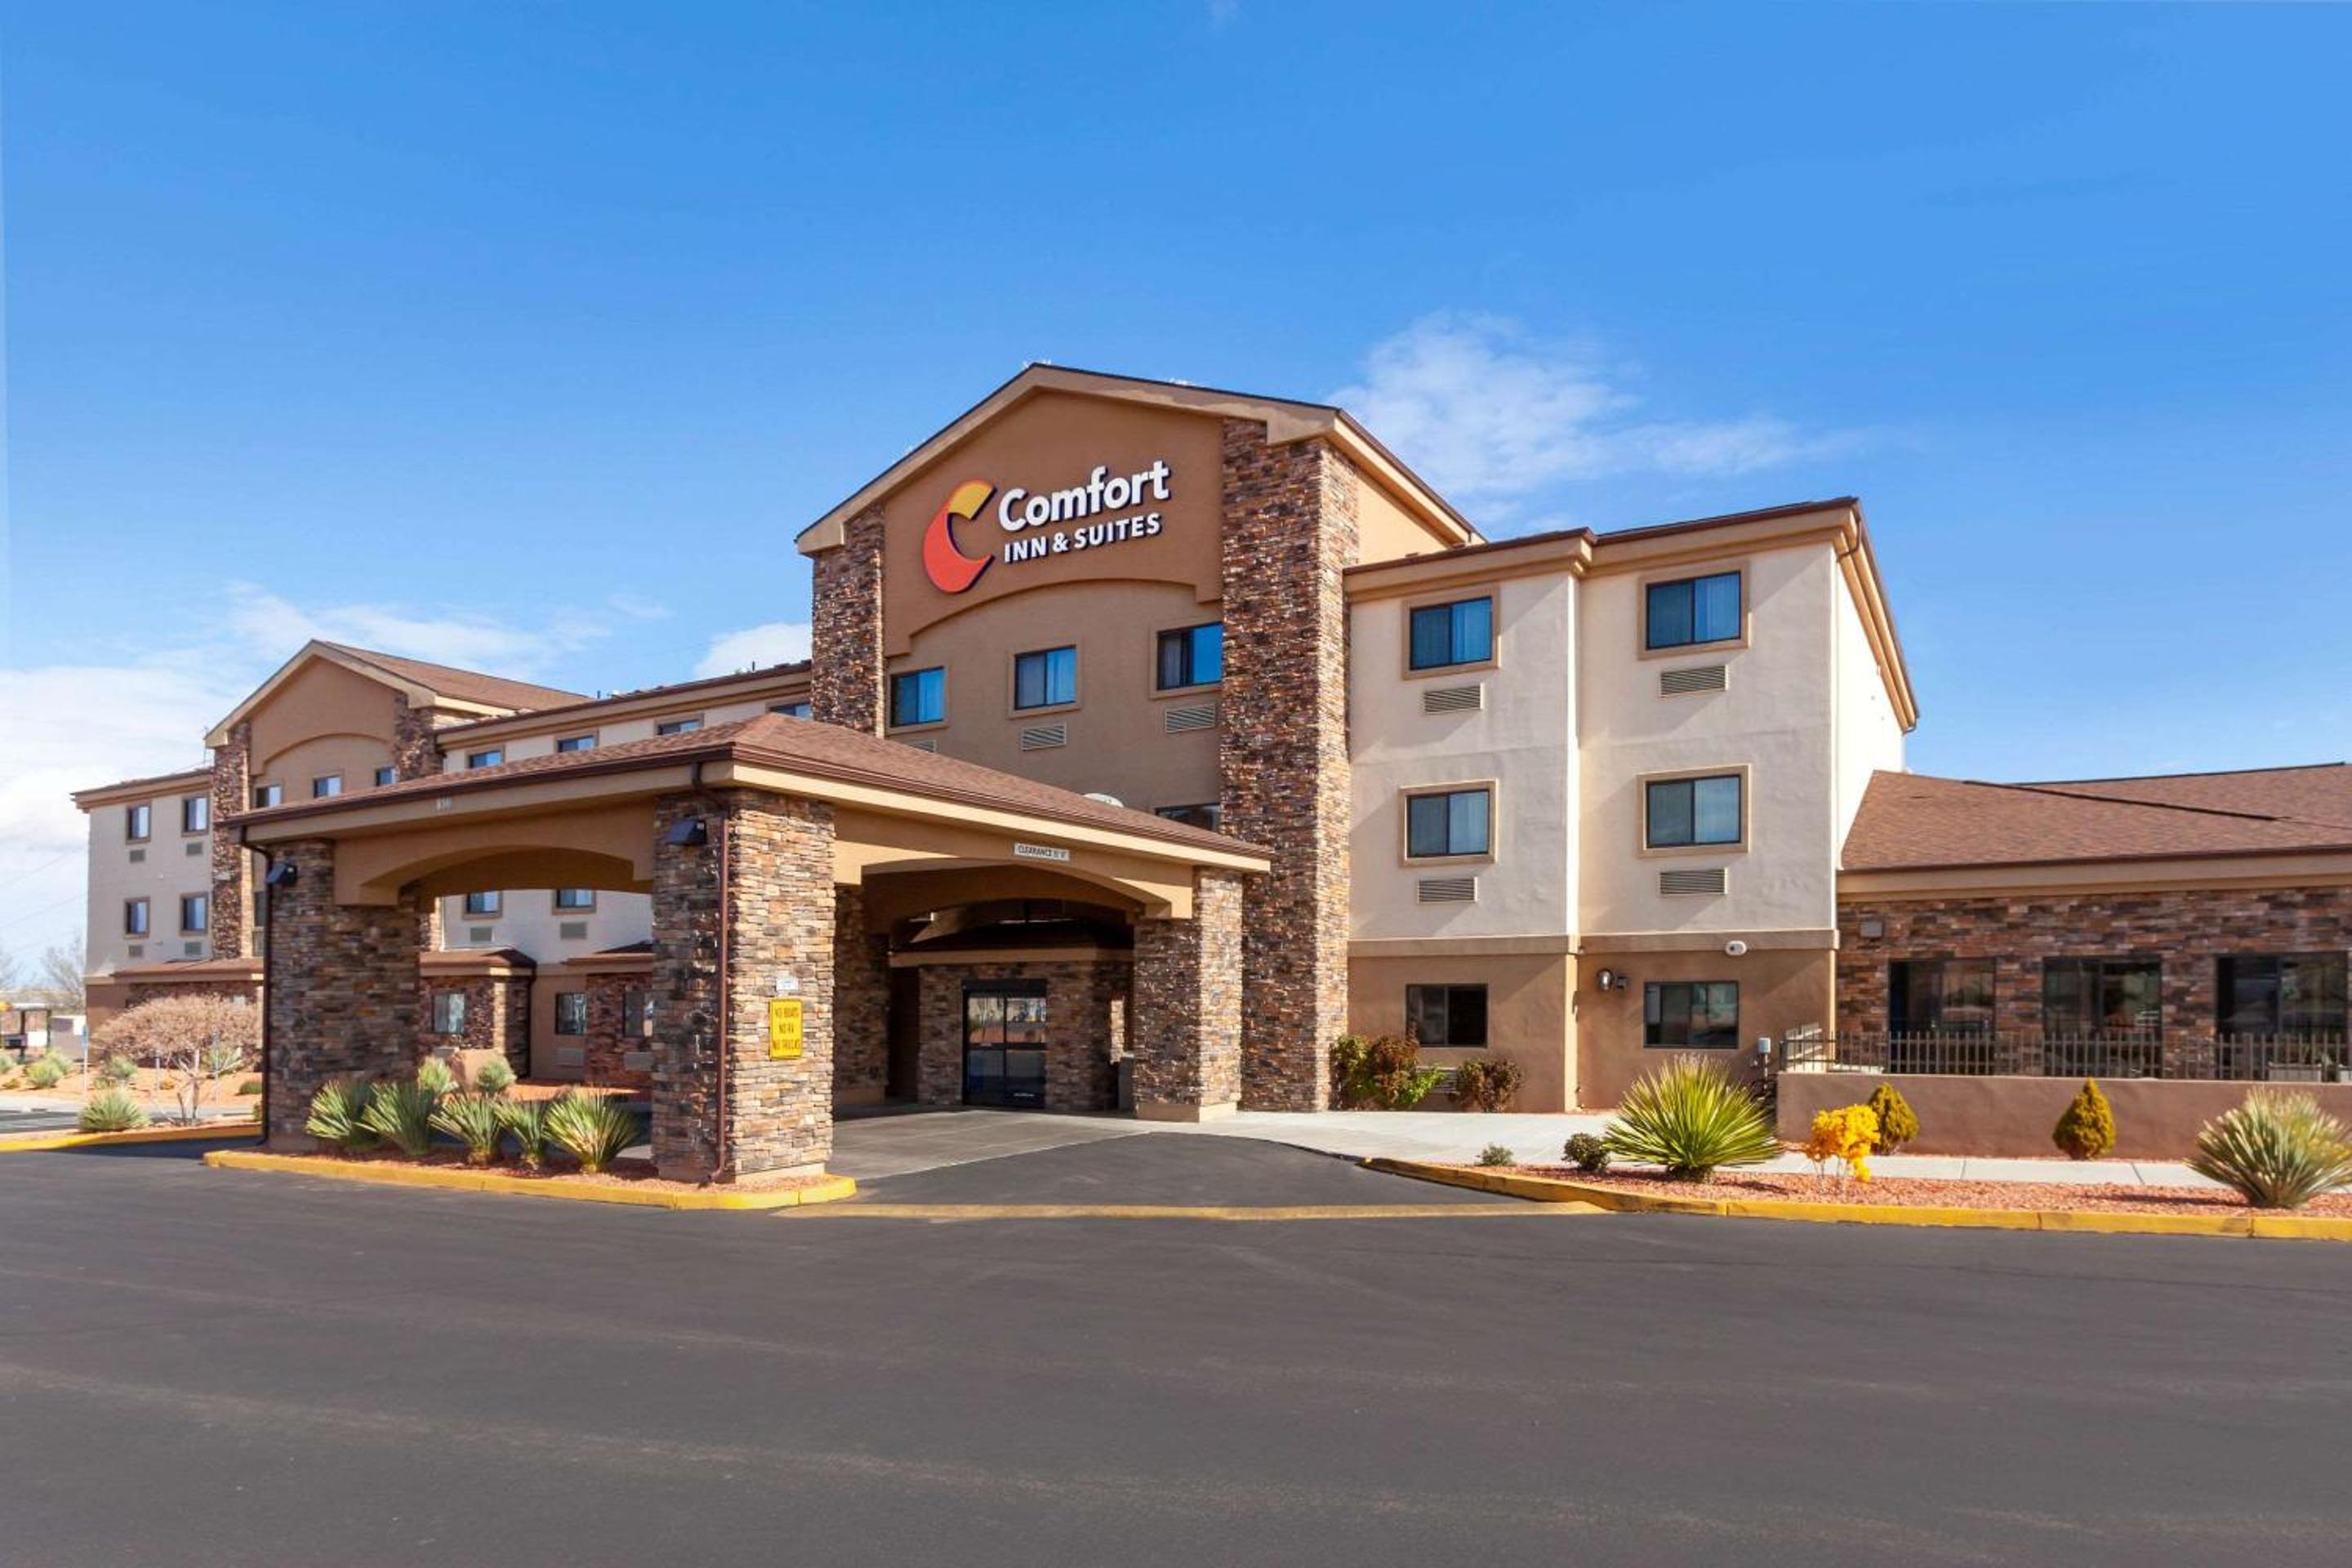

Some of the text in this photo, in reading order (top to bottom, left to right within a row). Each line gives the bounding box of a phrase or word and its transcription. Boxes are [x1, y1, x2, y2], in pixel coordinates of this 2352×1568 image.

[998, 460, 1169, 532] Comfort
[1004, 512, 1161, 563] INN & SUITES
[1018, 844, 1052, 857] CLEARANCE
[778, 1022, 786, 1034] NO
[772, 1038, 781, 1050] NO
